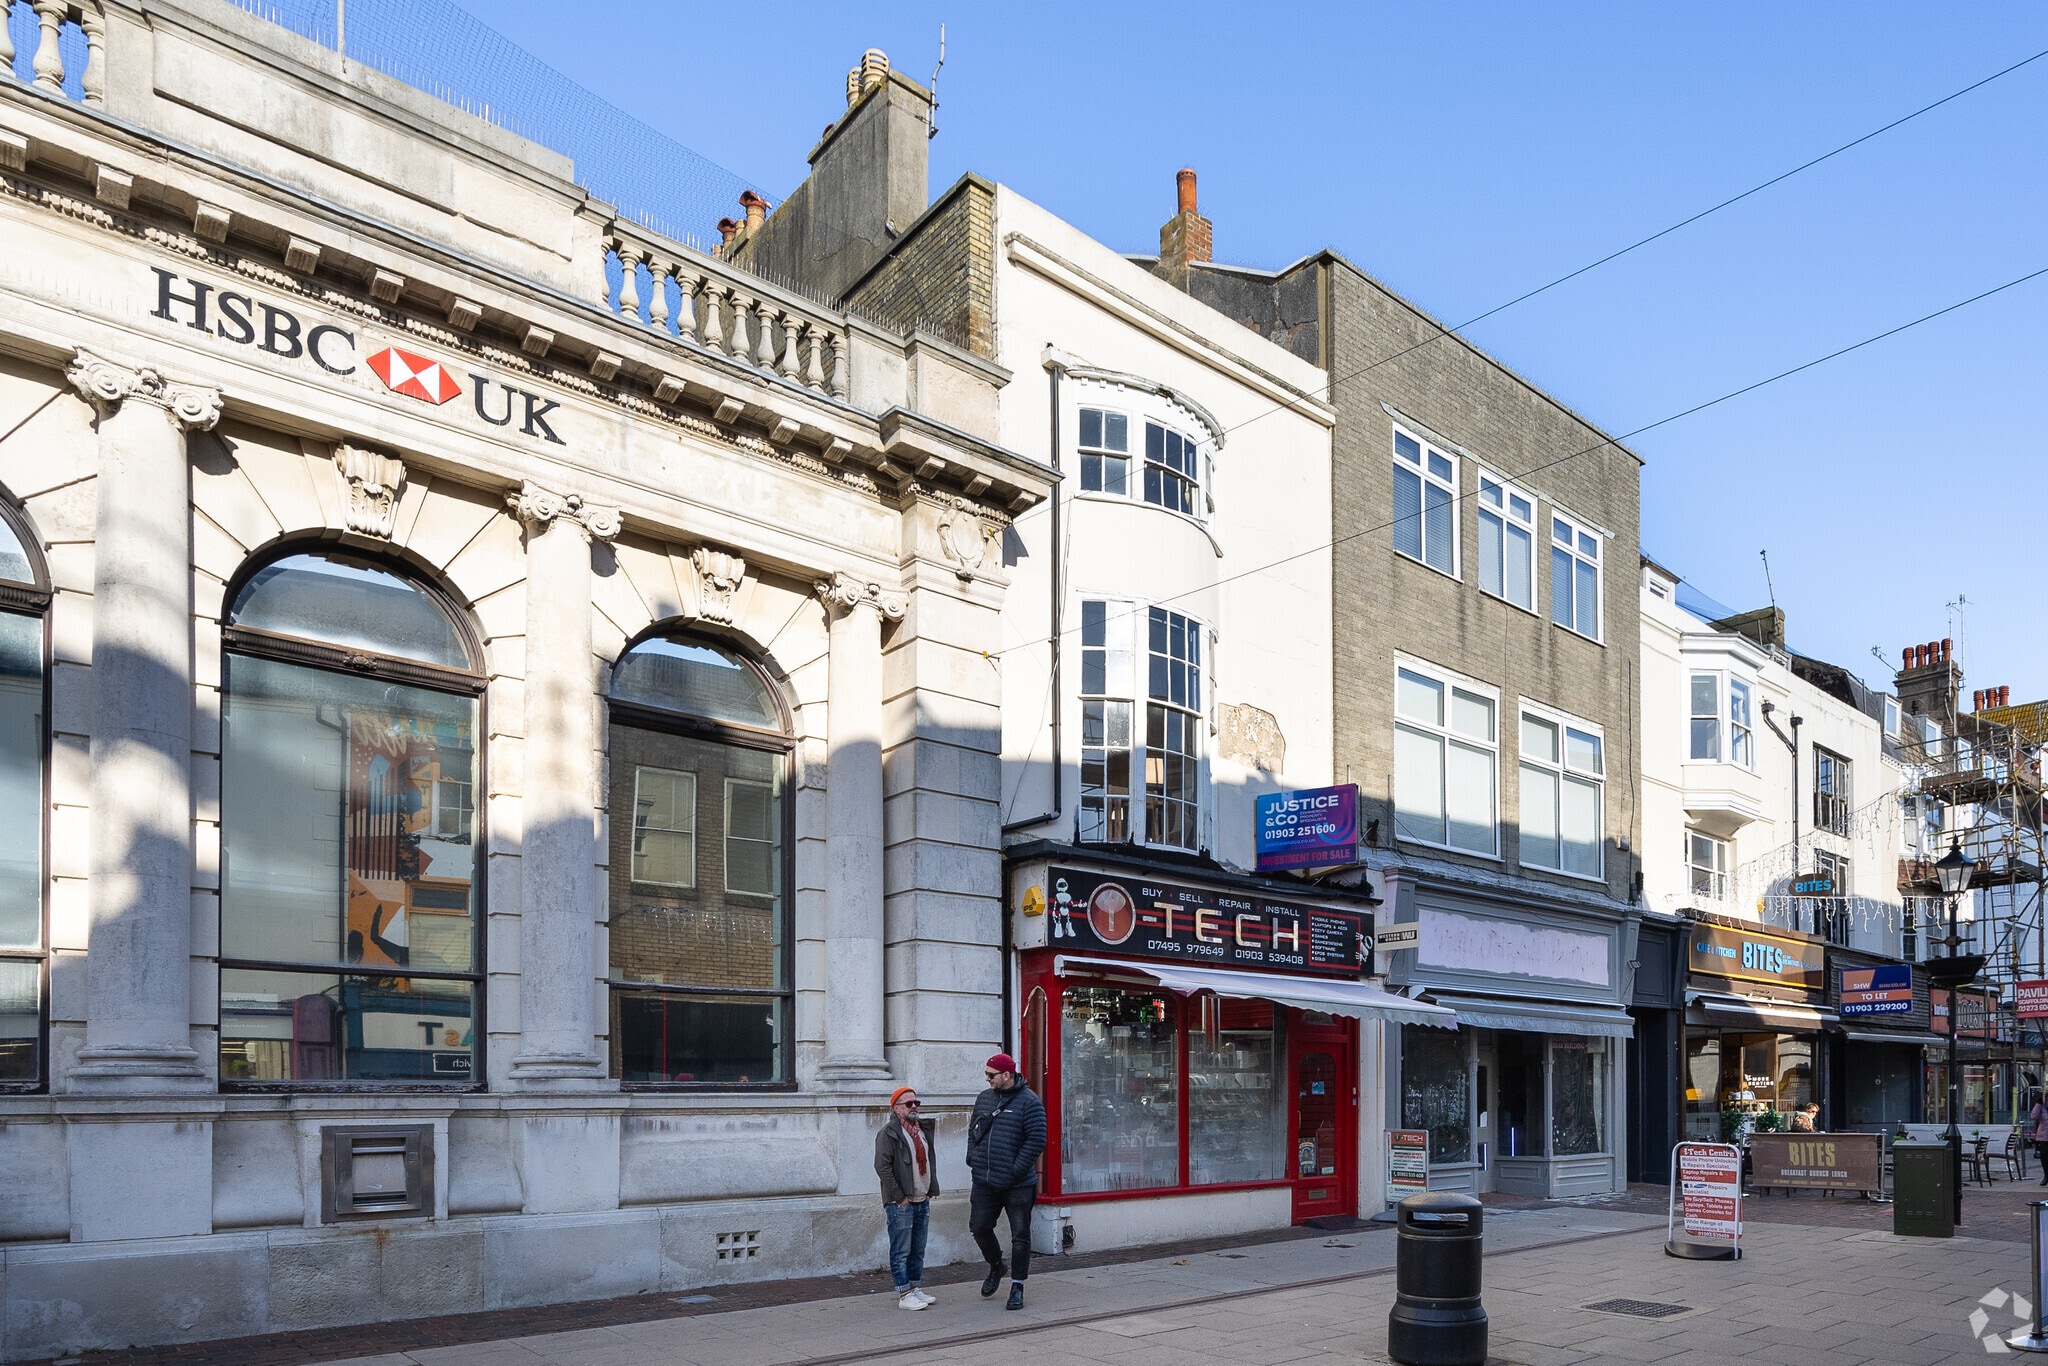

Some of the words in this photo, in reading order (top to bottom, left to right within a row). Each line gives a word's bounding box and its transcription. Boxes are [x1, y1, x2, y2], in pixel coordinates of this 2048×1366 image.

[150, 266, 356, 376] HSBC
[468, 373, 567, 446] UK
[1265, 795, 1339, 815] JUSTICE
[1265, 828, 1295, 840] 01903
[1297, 823, 1336, 836] 251600
[1261, 852, 1310, 867] INVESTMENT
[1312, 851, 1328, 862] FOR
[1329, 848, 1351, 860] SALE
[1795, 879, 1832, 893] BITES
[1142, 887, 1163, 898] BUY
[1179, 892, 1204, 904] SELL
[1218, 898, 1251, 911] REPAIR
[1265, 905, 1301, 917] INSTALL
[1402, 930, 1414, 940] WU
[1148, 939, 1181, 952] 07495
[1186, 943, 1224, 957] 979649
[1235, 949, 1264, 961] 01903
[1268, 953, 1304, 965] 539408
[1742, 941, 1783, 974] BITES
[1844, 1004, 1872, 1012] 01903
[1874, 1002, 1908, 1012] 229200
[1708, 1150, 1734, 1158] Centre
[1788, 1142, 1836, 1167] BITES
